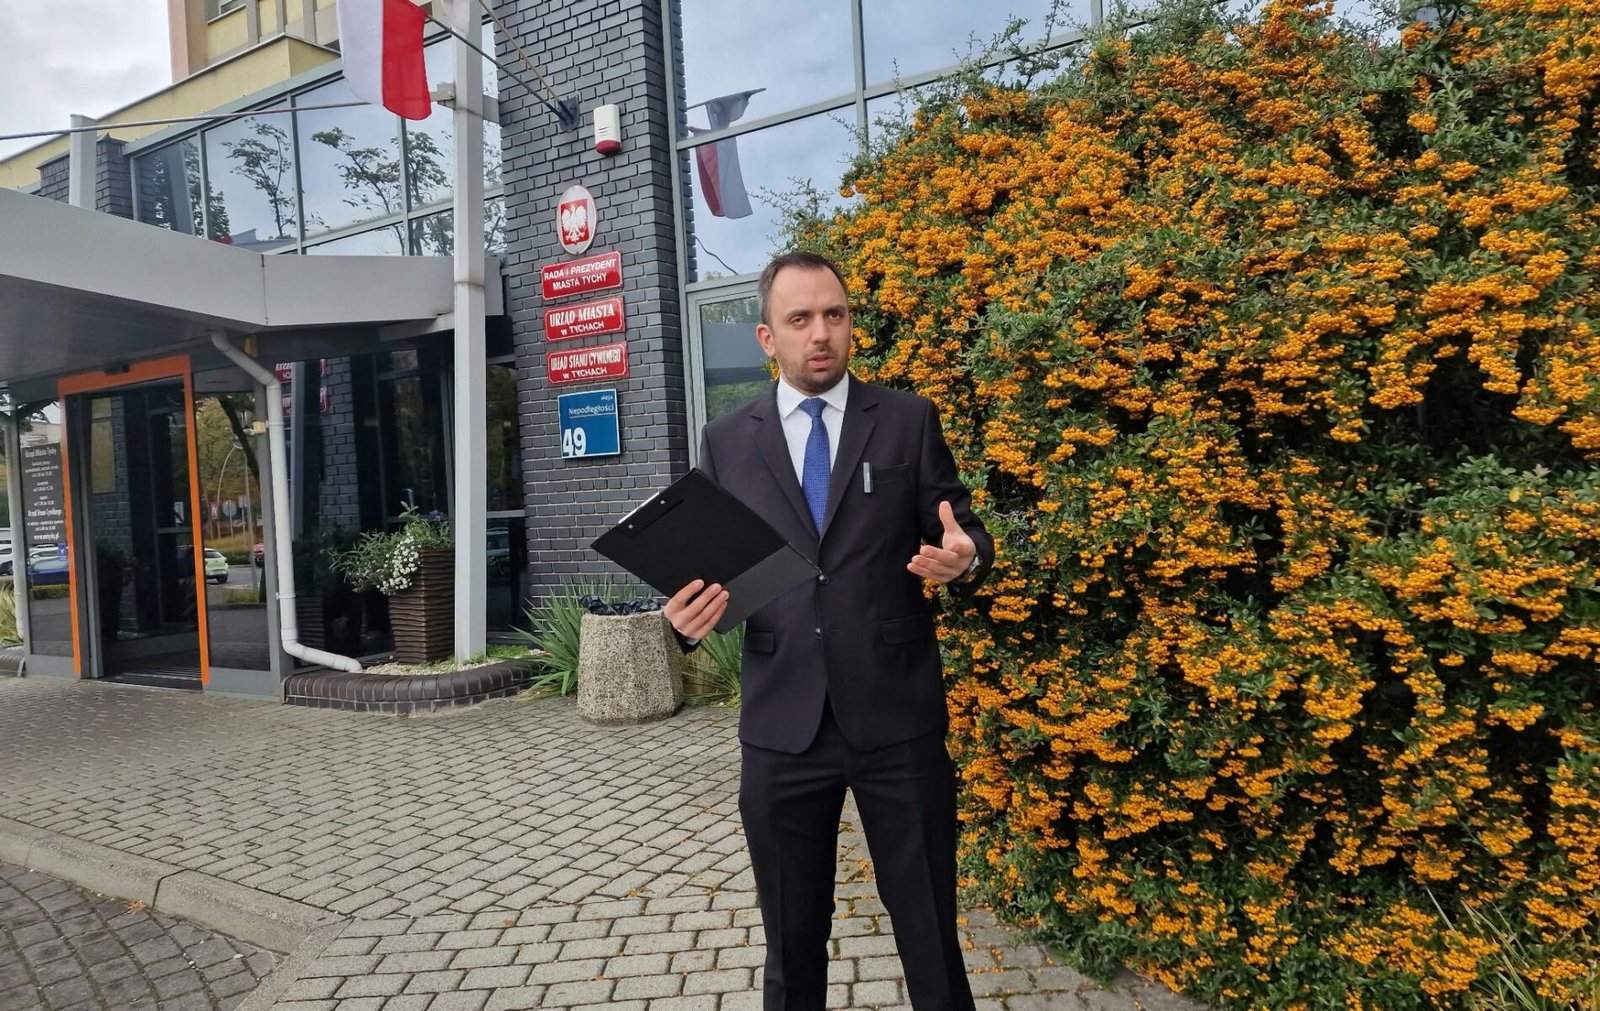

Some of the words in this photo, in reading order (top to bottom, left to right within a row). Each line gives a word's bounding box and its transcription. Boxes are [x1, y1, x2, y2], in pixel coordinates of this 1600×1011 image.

[544, 270, 564, 280] RADA
[570, 259, 616, 274] PREZYDENT
[552, 279, 580, 290] MIASTA
[582, 272, 607, 284] TYCHY
[550, 310, 575, 327] URZĄD
[578, 304, 615, 321] MIASTA
[569, 321, 604, 334] TYCHACH
[551, 356, 568, 370] URZĄD
[569, 353, 588, 368] STANU
[589, 349, 620, 366] CYWILNEGO
[571, 367, 607, 378] TYCHACH
[568, 404, 614, 414] Niepodległości
[562, 427, 587, 457] 49
